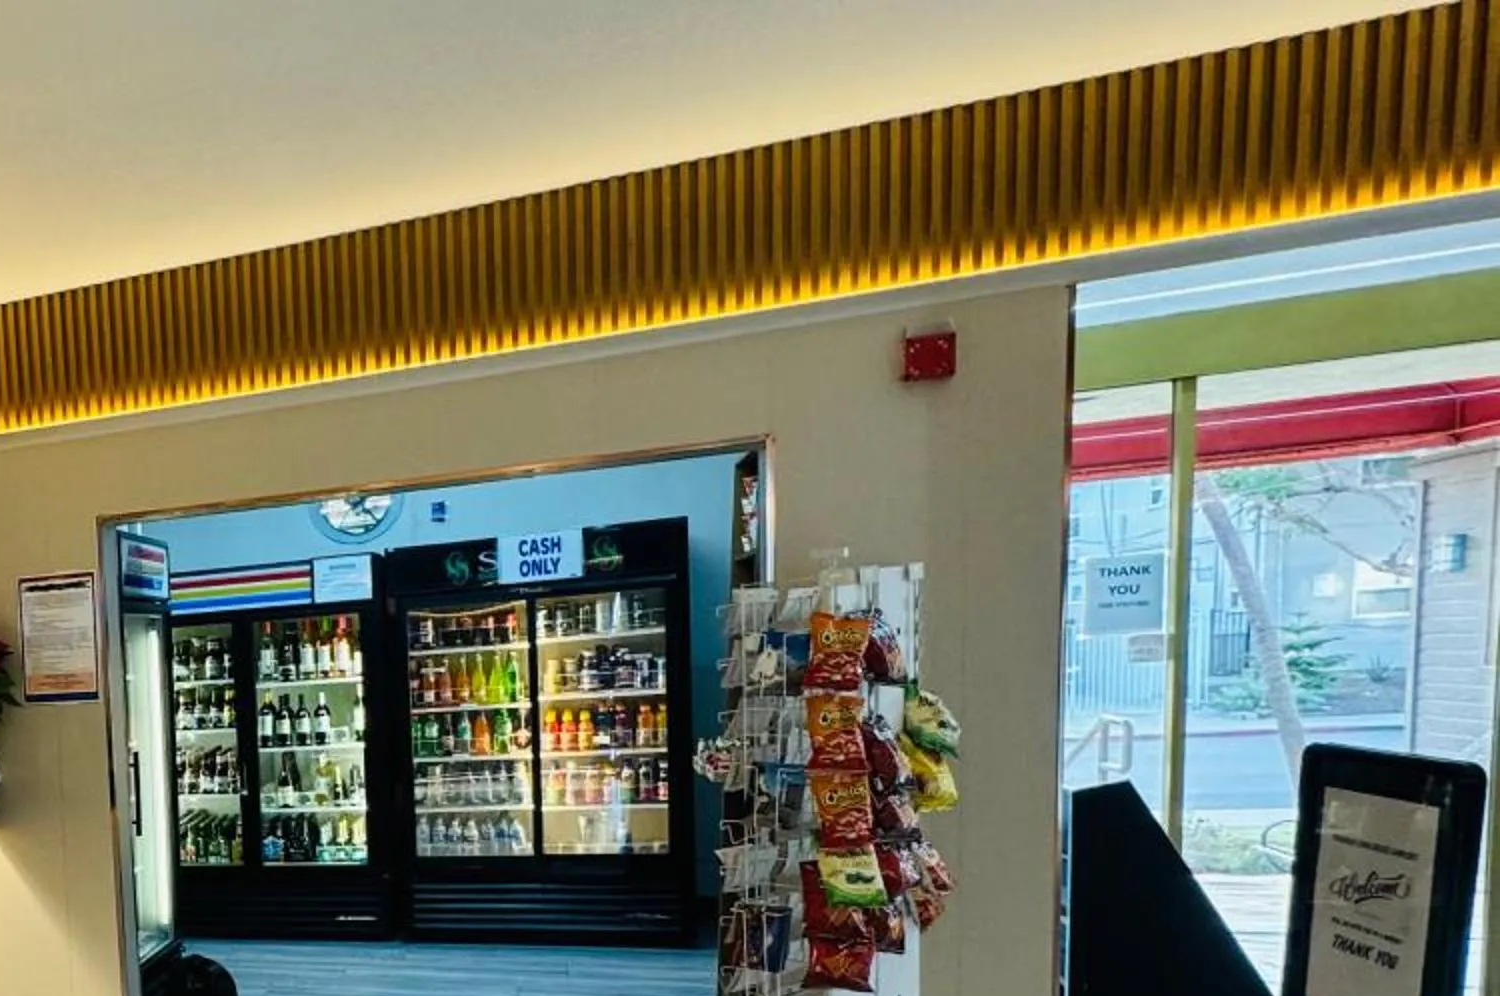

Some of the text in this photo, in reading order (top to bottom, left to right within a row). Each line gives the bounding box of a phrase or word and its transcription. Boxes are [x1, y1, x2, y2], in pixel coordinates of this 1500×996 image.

[518, 536, 562, 557] CASH
[519, 557, 561, 577] ONLY
[1099, 565, 1152, 577] THANK
[1108, 584, 1140, 596] YOU
[1332, 933, 1400, 970] THANK YOU
